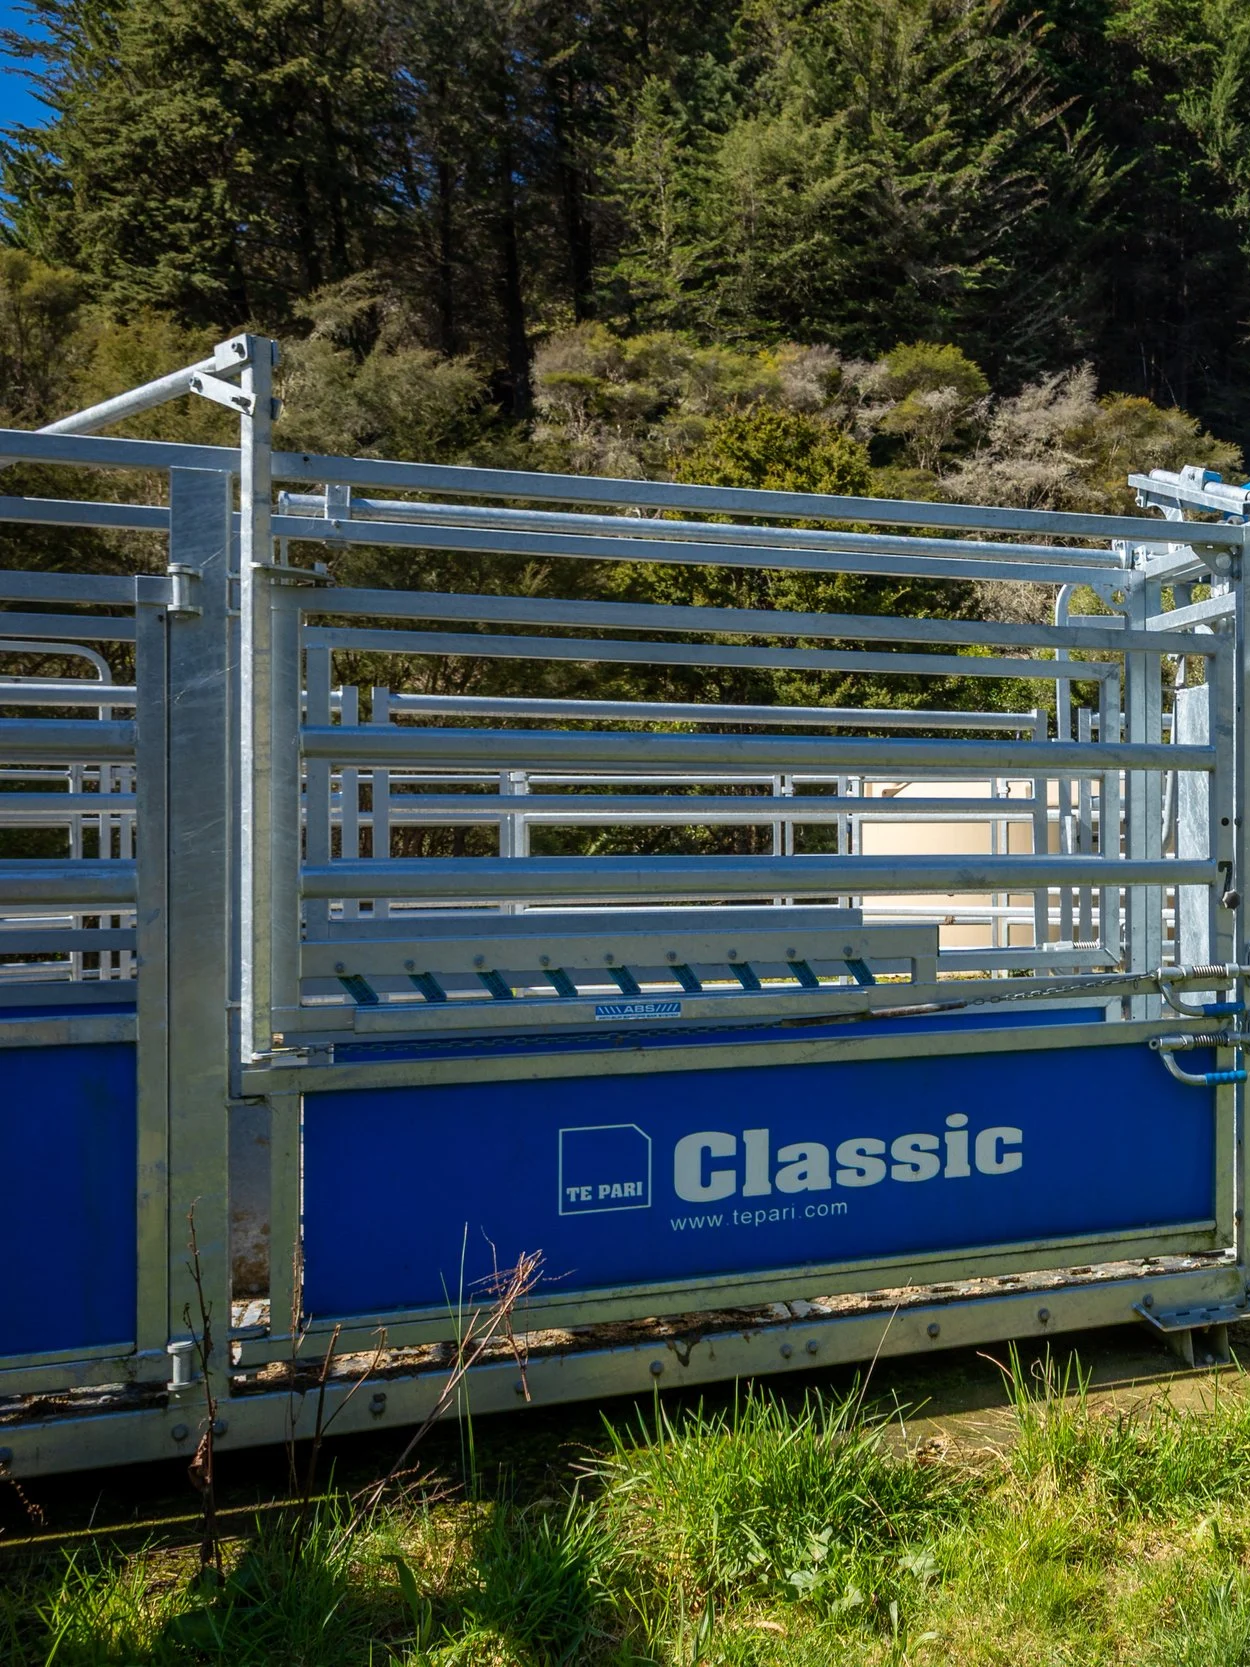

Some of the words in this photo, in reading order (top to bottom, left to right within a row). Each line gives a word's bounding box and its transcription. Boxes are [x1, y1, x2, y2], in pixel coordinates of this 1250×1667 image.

[623, 1004, 655, 1014] ABS
[674, 1113, 1023, 1203] Classic
[566, 1186, 593, 1202] TE
[598, 1181, 643, 1200] PARI
[670, 1202, 848, 1231] www.tepari.com
